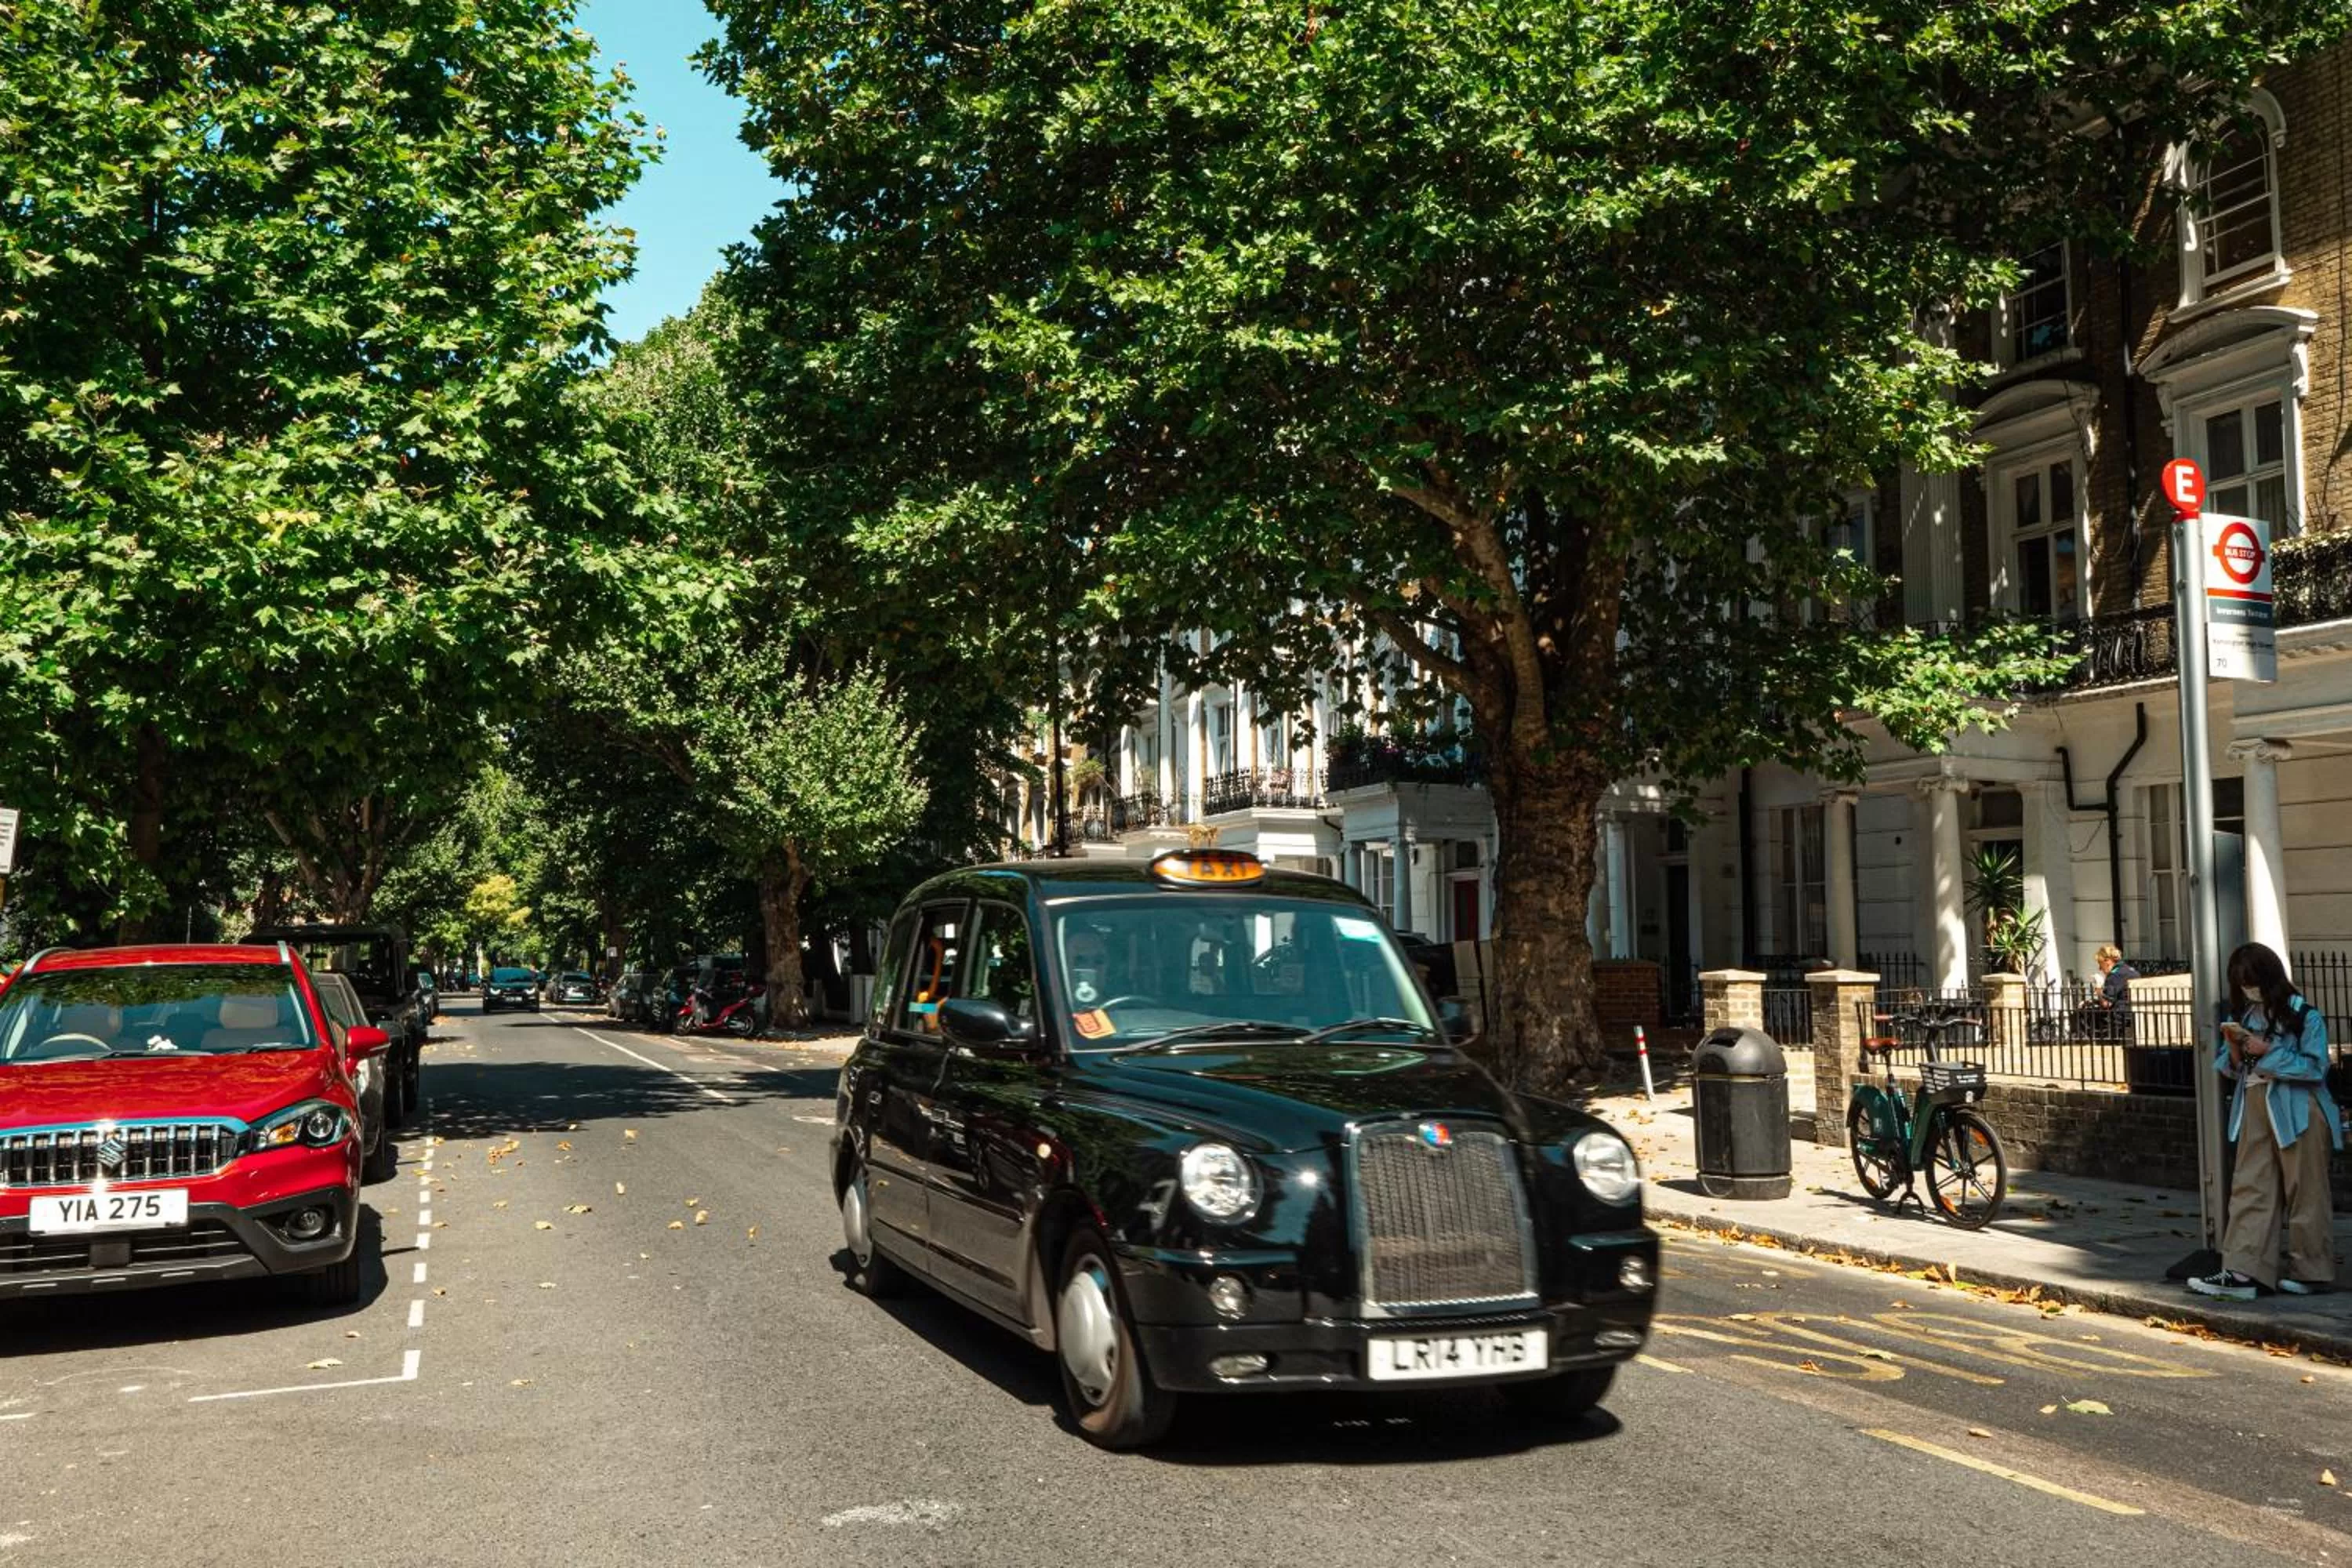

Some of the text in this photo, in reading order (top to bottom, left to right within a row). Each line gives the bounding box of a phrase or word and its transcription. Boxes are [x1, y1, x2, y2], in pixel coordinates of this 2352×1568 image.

[2175, 465, 2197, 503] E
[2224, 547, 2256, 559] BUS STOP
[58, 1195, 161, 1222] YIA 275
[1392, 1338, 1460, 1370] LR14
